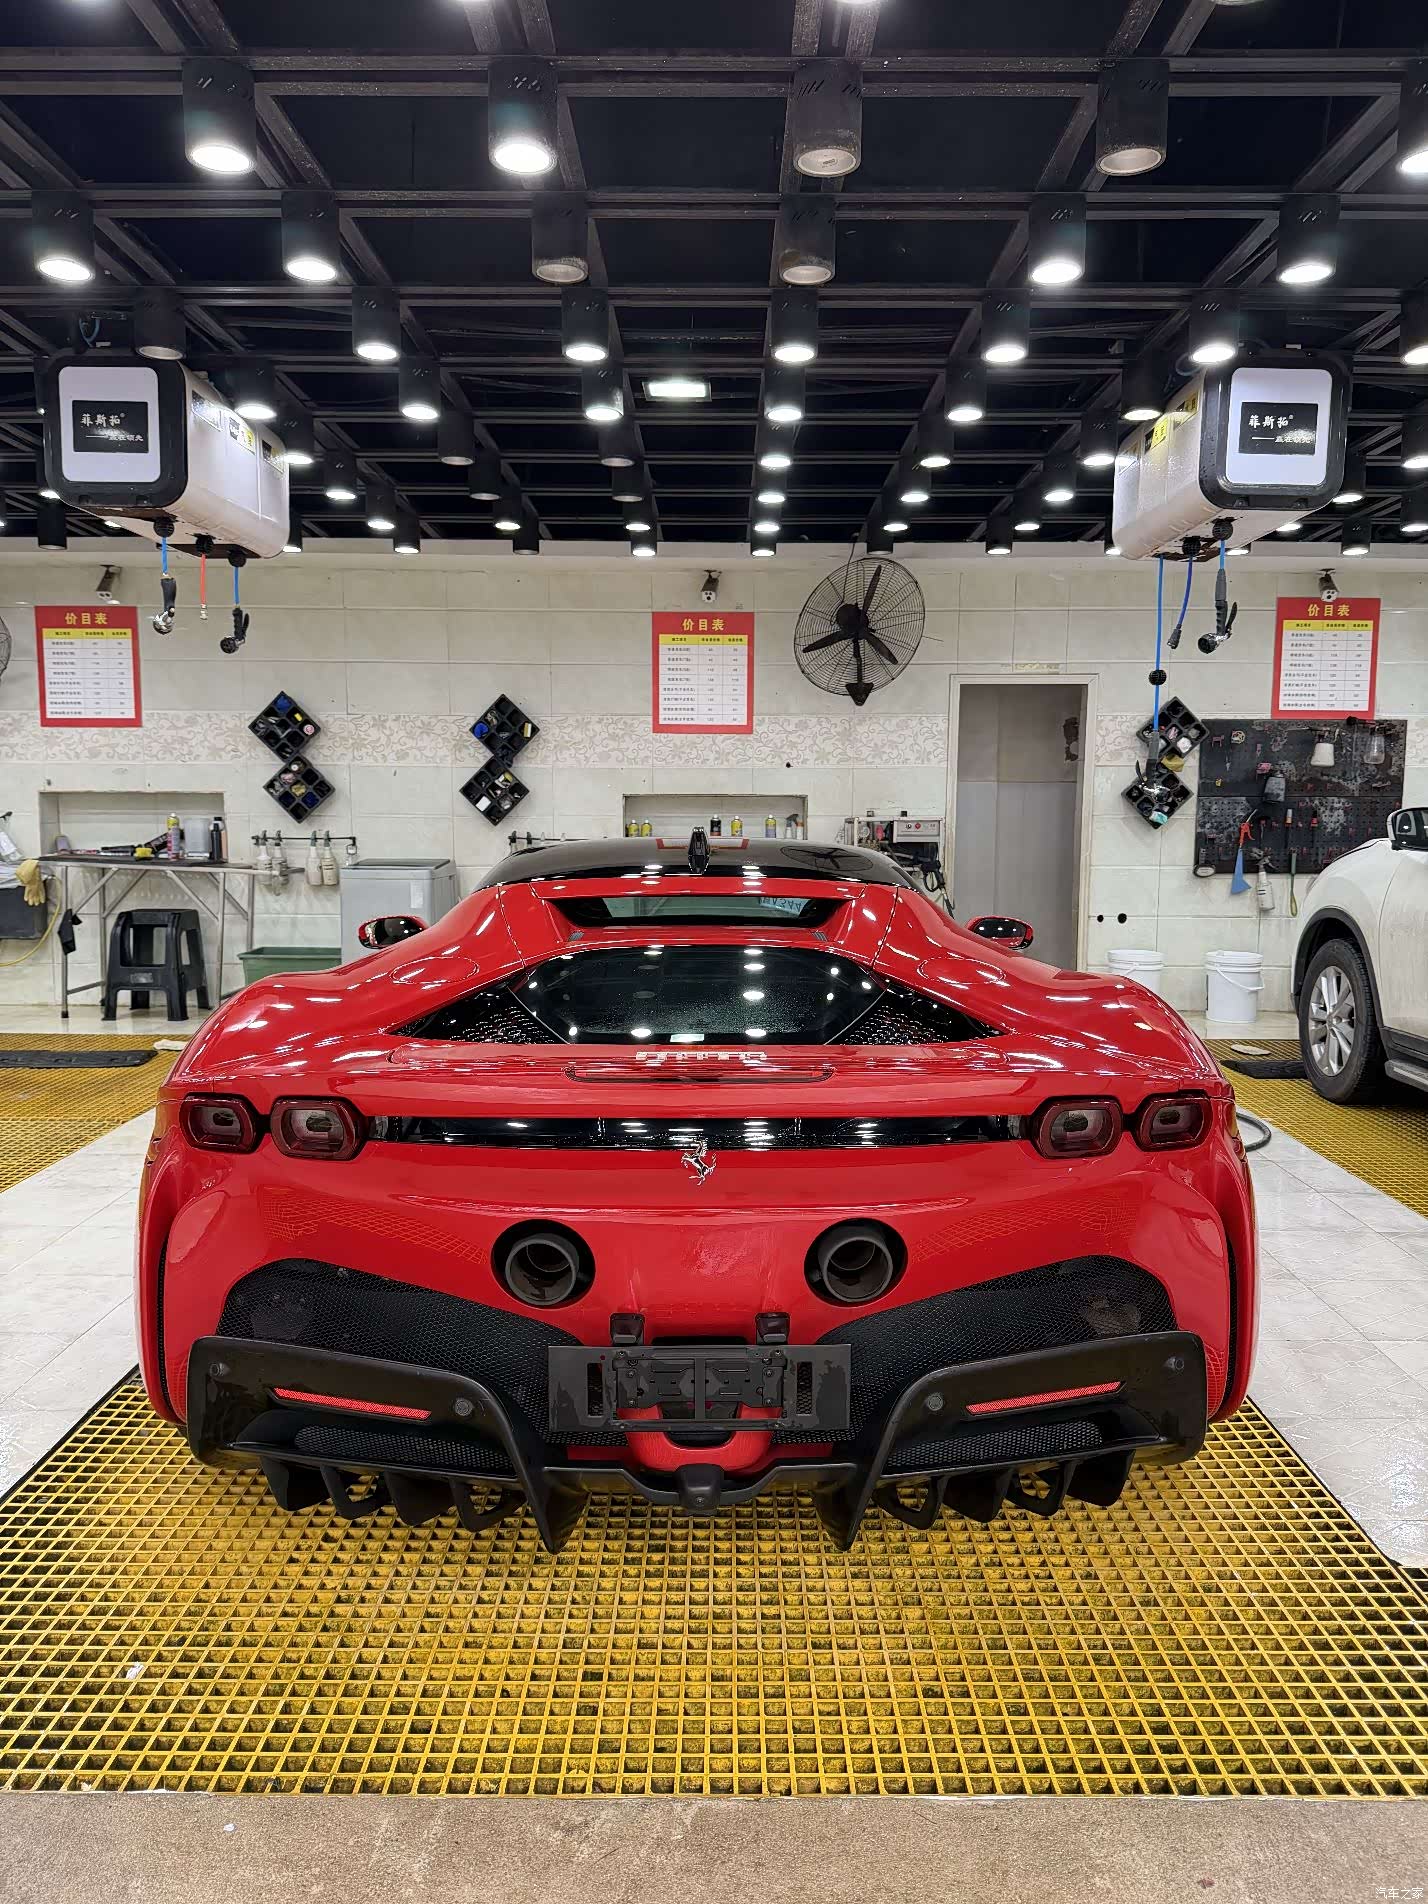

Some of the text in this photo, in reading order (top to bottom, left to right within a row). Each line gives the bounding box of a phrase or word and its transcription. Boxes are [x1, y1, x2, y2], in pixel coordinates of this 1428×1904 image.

[80, 413, 121, 427] 菲斯拓
[1248, 414, 1289, 429] 菲斯拓
[1307, 604, 1350, 617] 价目表
[65, 612, 108, 625] 价目表
[682, 618, 725, 631] 价目表
